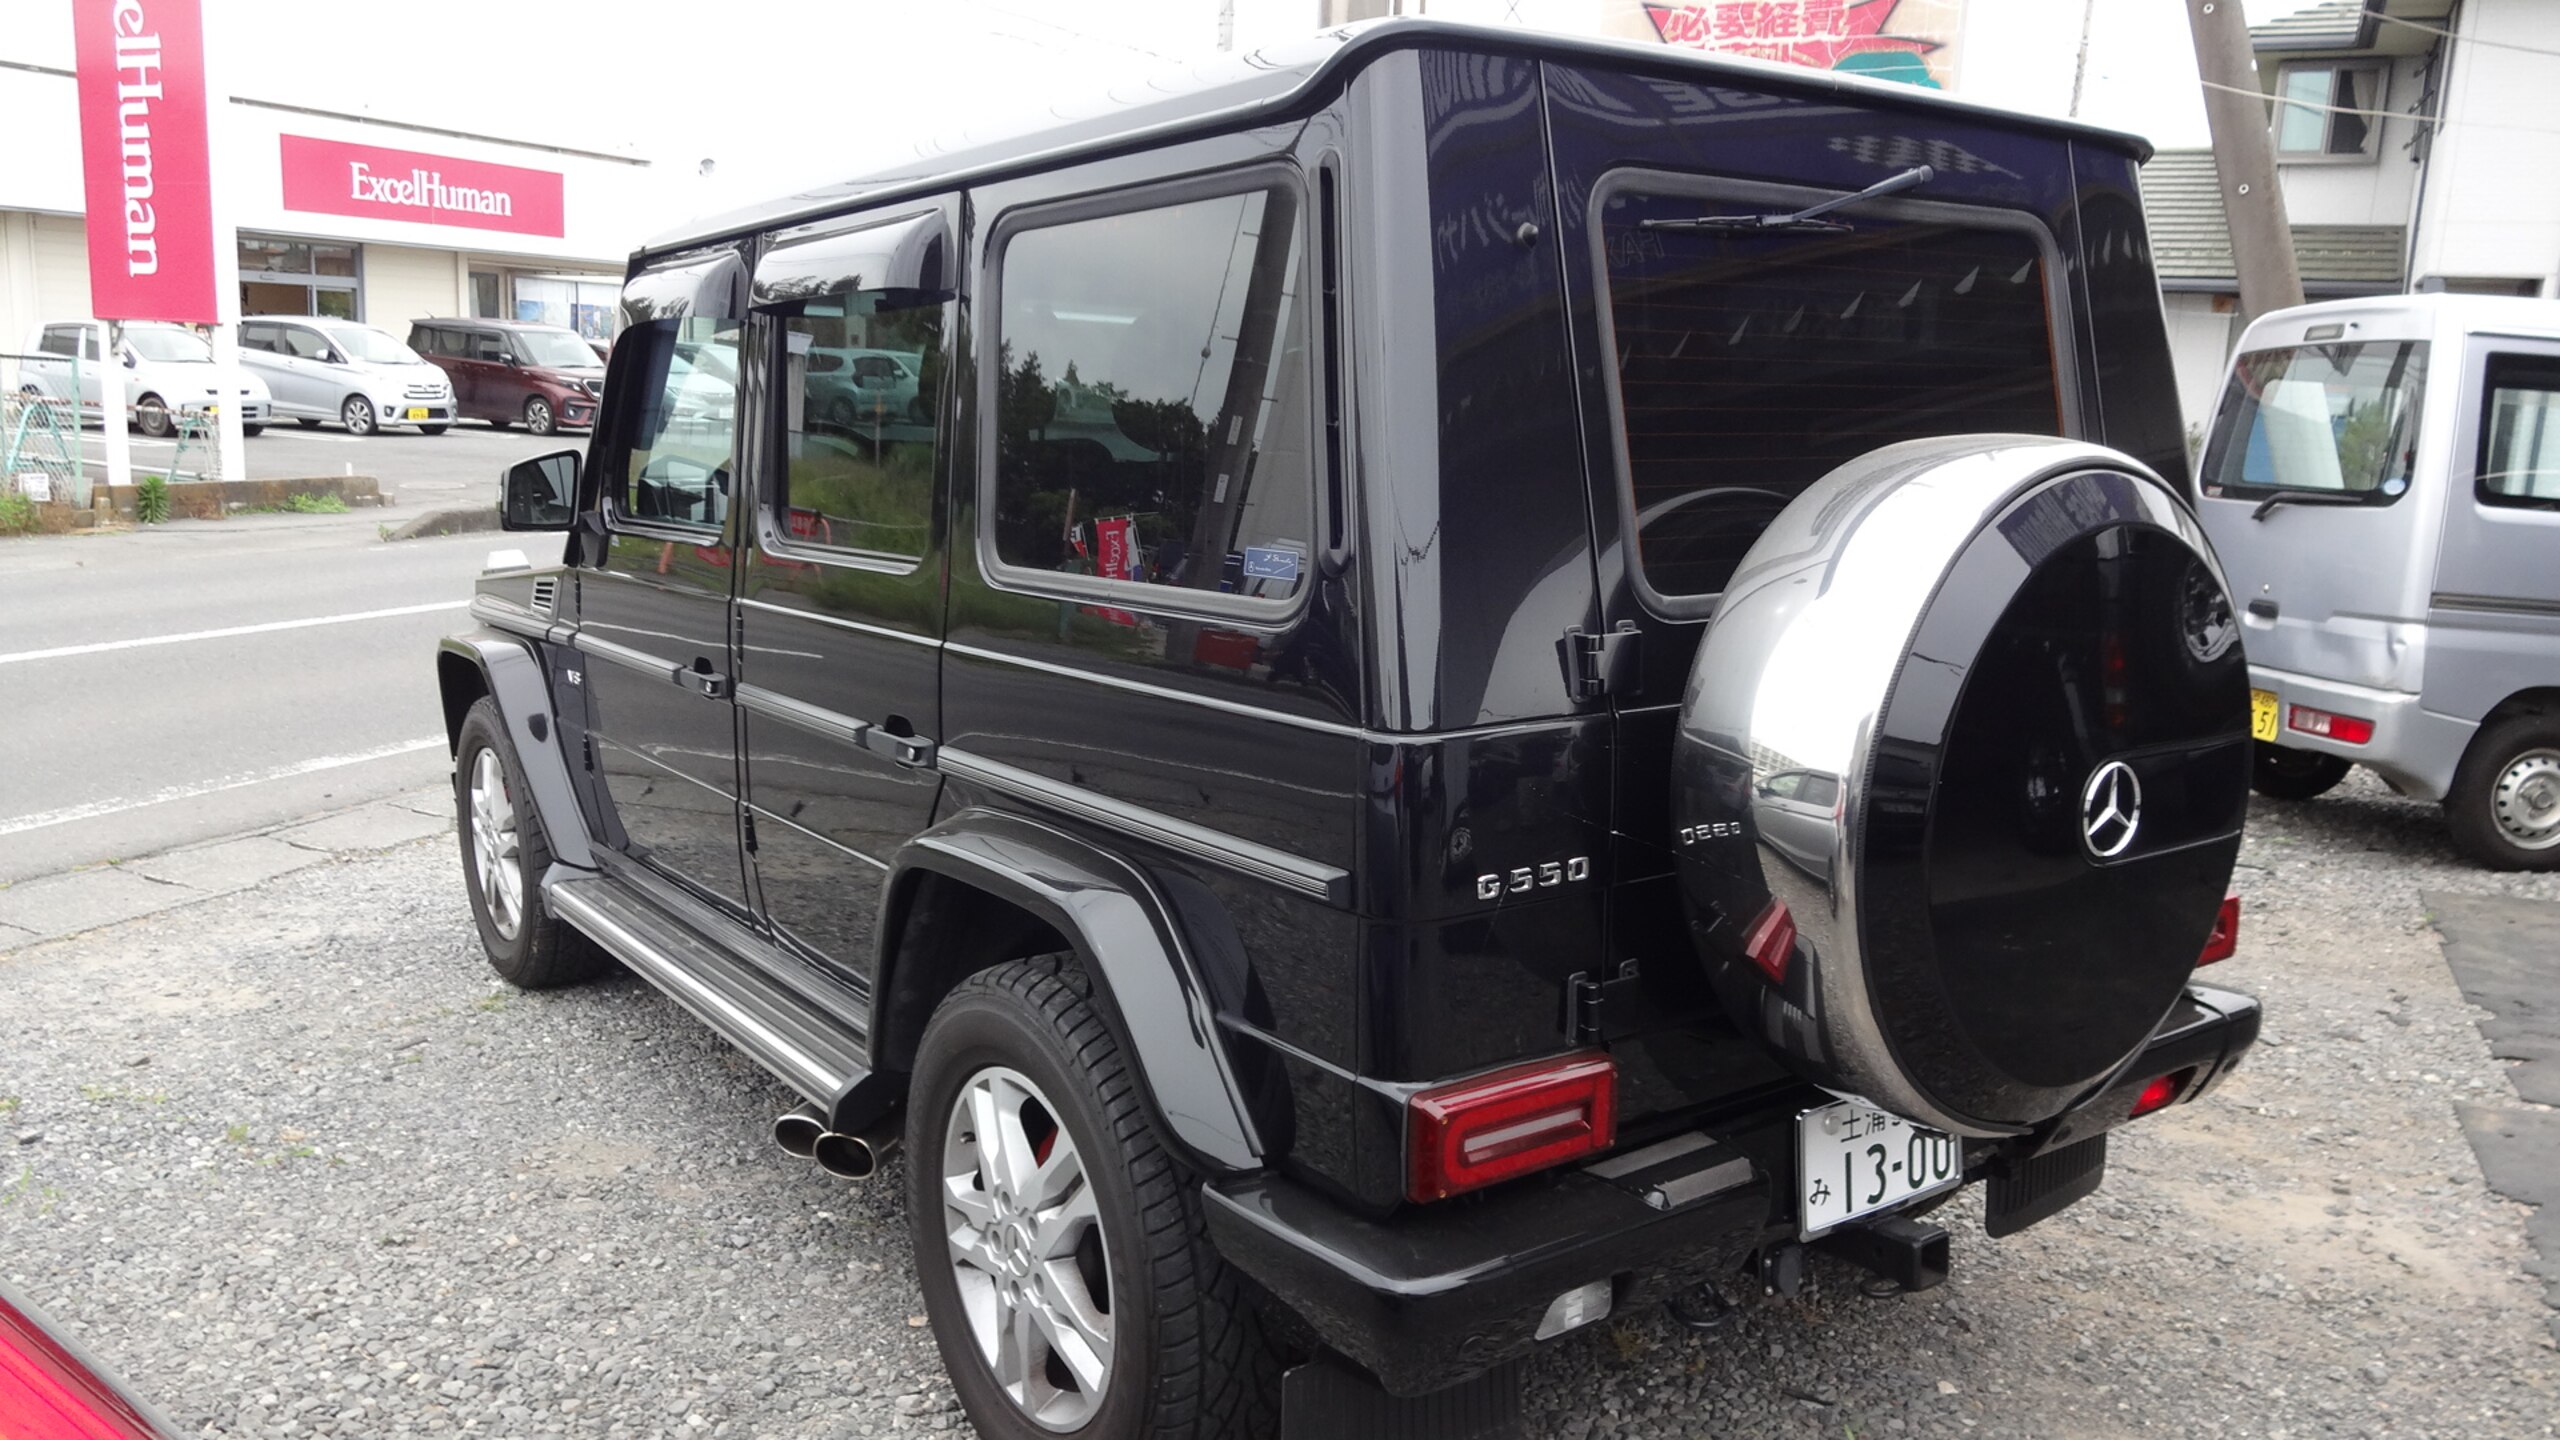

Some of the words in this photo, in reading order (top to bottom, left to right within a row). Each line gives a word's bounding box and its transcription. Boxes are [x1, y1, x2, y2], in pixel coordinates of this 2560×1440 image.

[349, 161, 513, 216] ExcelHuman
[1809, 1178, 1831, 1206] み
[1845, 1131, 1950, 1214] 13-00
